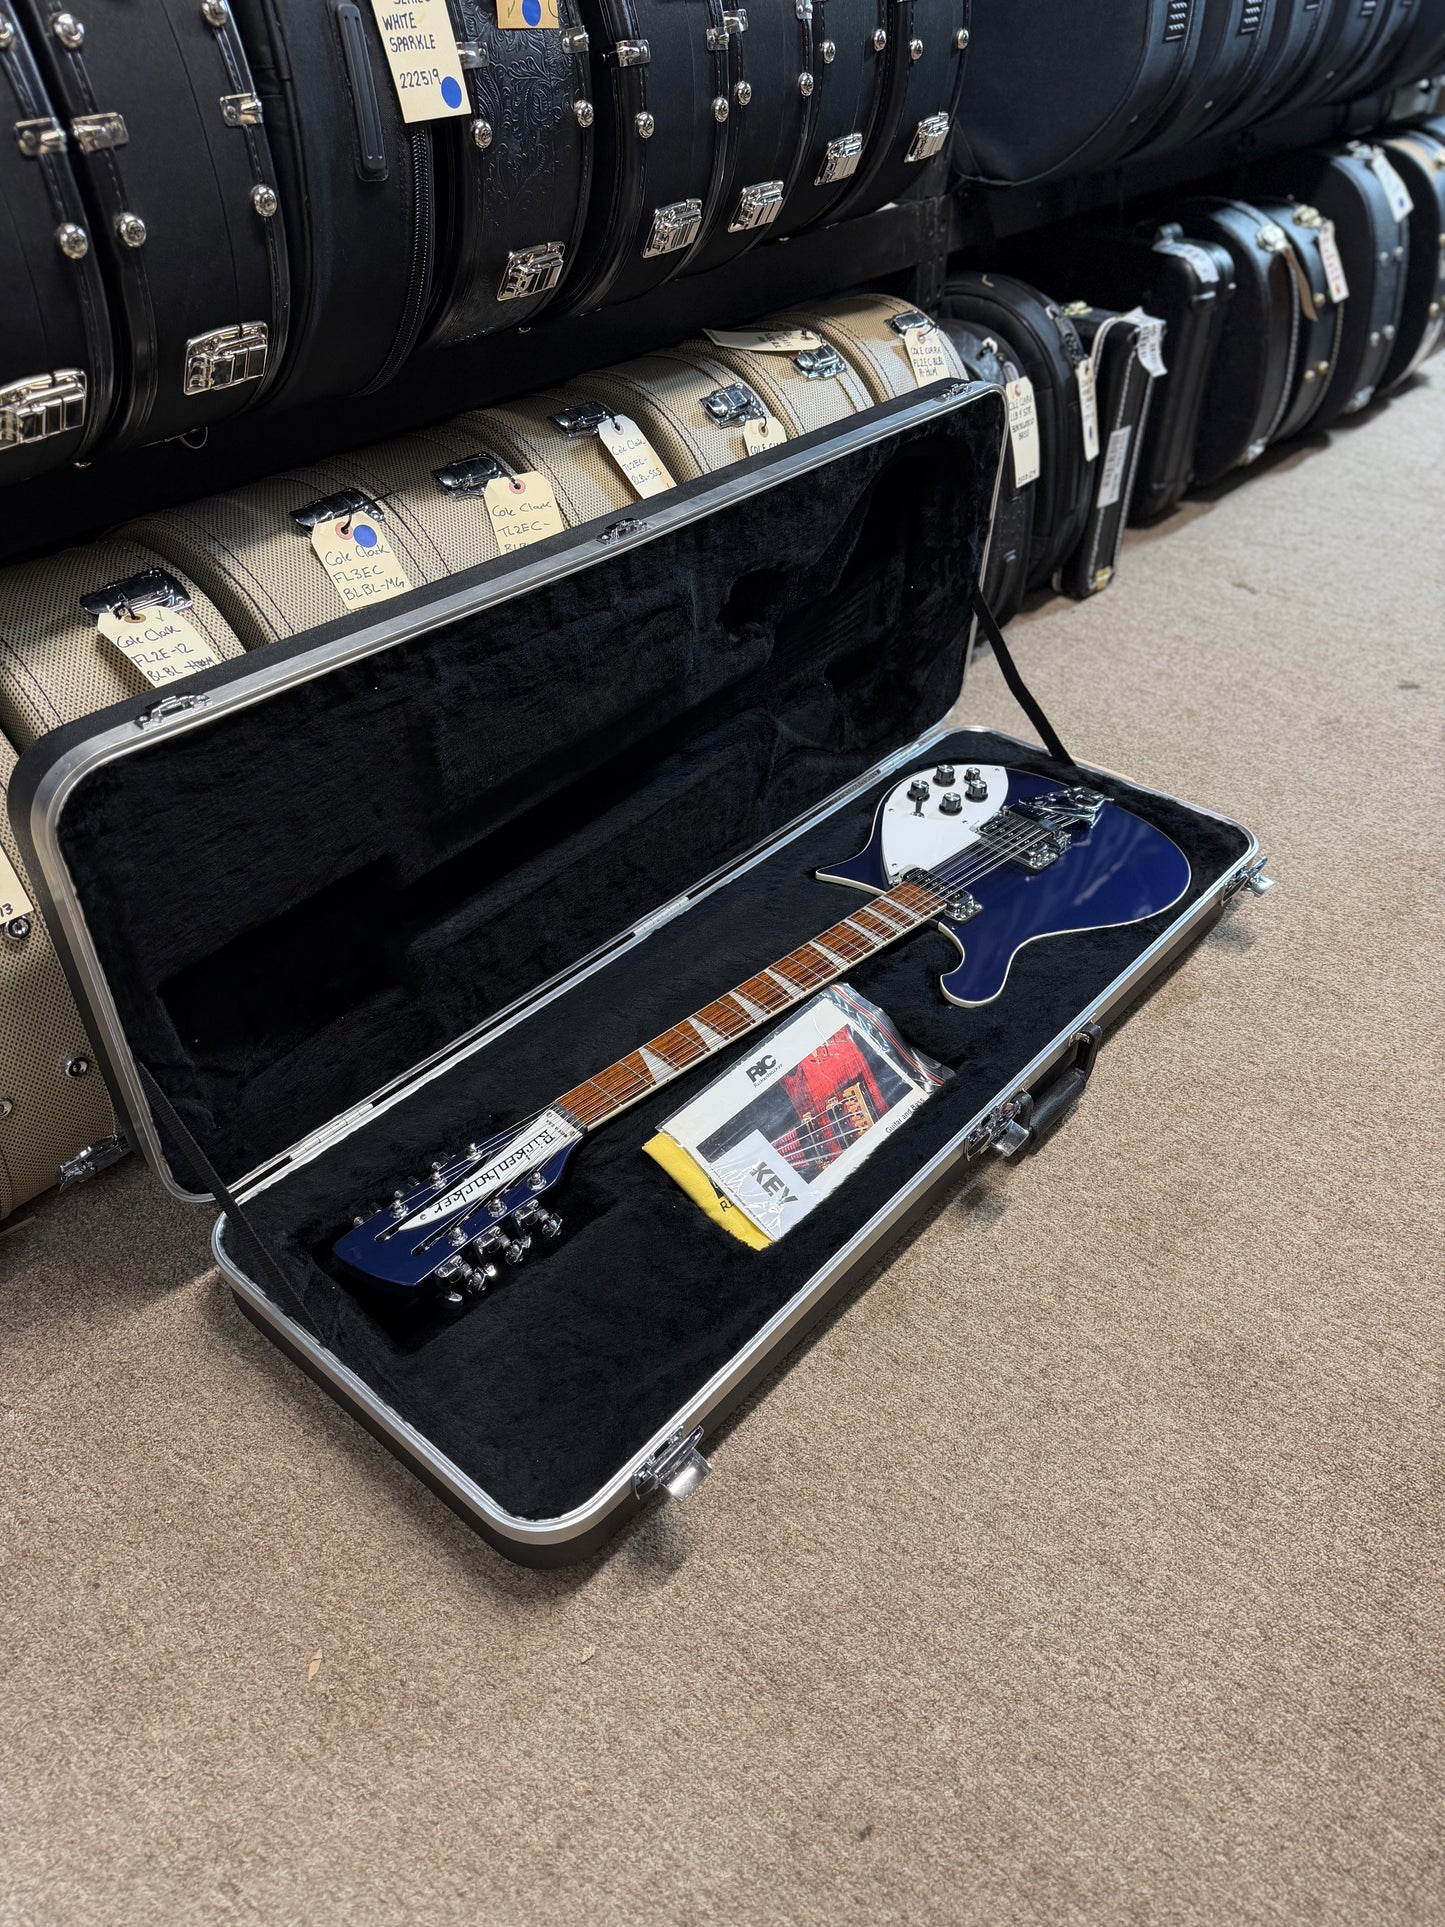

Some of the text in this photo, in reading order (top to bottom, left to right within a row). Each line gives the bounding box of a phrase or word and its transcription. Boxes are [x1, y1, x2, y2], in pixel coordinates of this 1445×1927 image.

[382, 11, 417, 31] WHITE
[389, 34, 436, 53] SPARKLE
[400, 68, 442, 89] 222519
[492, 501, 552, 517] Cole Clark
[324, 544, 391, 566] Cole Clark
[333, 565, 384, 583] FL3EC
[343, 577, 405, 601] BLBL-MG
[117, 625, 181, 648] Cole Clark
[746, 1055, 777, 1083] RIC
[885, 1097, 926, 1134] Guitar and Bass
[434, 1129, 555, 1214] Rickenbacker
[749, 1161, 799, 1206] KEY
